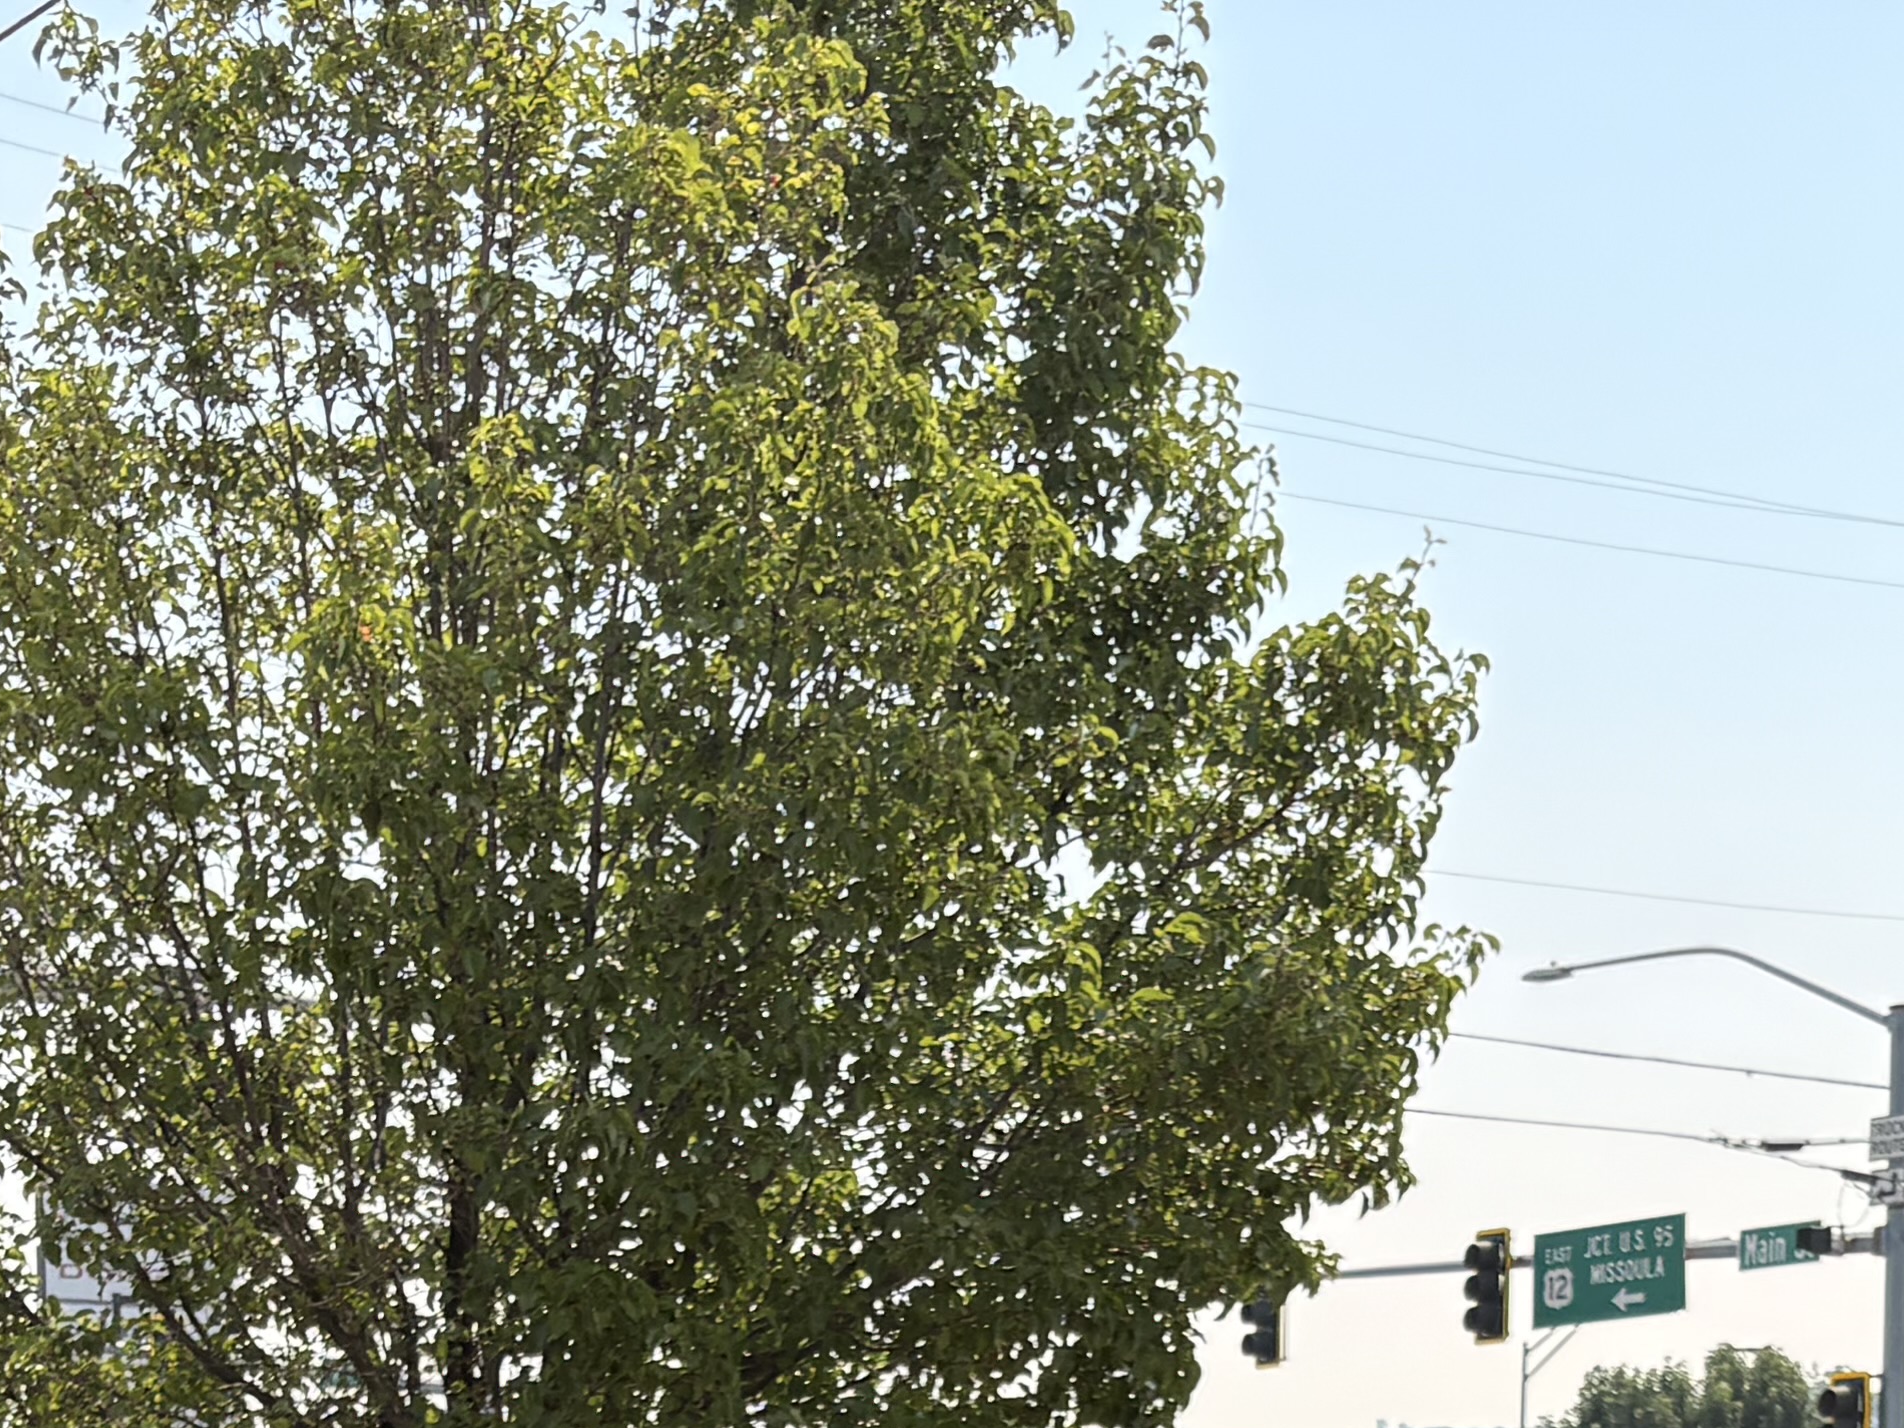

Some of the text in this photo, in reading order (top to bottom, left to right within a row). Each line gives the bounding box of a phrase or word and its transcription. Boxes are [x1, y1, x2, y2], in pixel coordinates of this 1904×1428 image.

[1654, 1225, 1674, 1247] 95
[1744, 1231, 1786, 1266] Main
[1545, 1246, 1572, 1265] EAST
[1590, 1255, 1665, 1285] MISSOULA
[1549, 1274, 1568, 1300] 12
